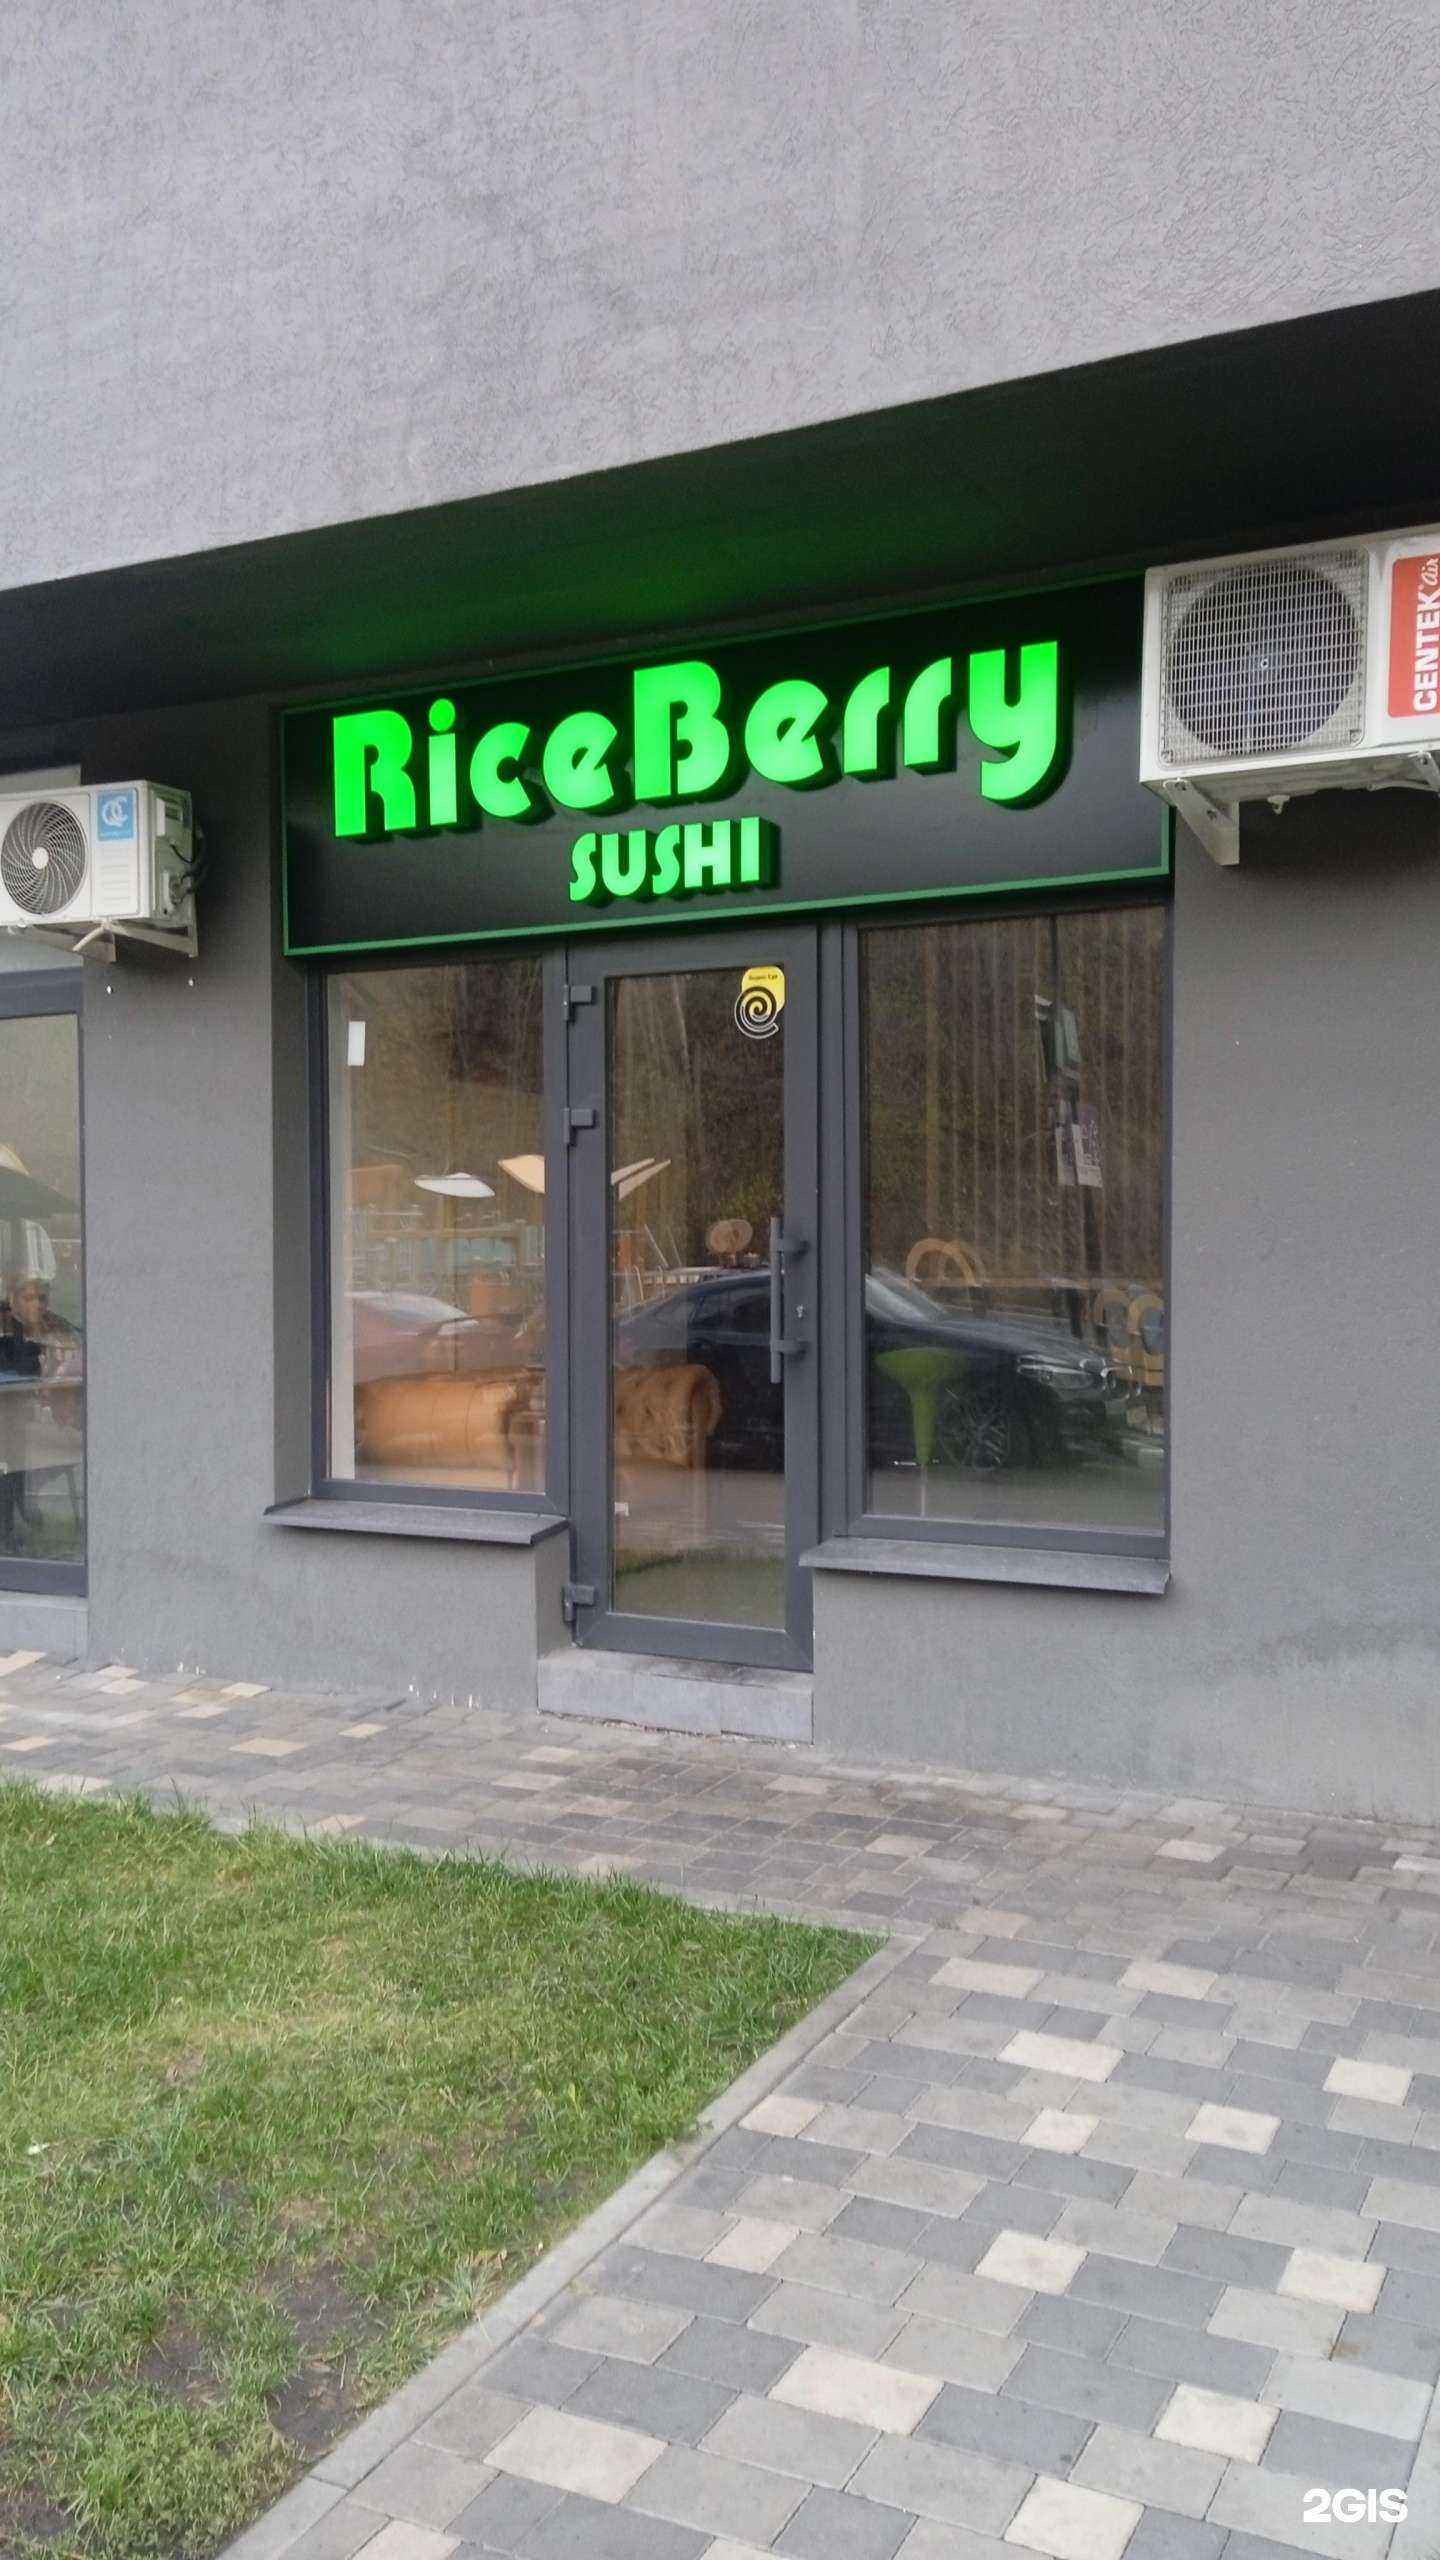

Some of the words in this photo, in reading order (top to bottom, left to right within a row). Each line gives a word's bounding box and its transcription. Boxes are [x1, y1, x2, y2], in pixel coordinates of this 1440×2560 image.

[1413, 589, 1440, 712] CENTEK
[333, 641, 1058, 837] RiceBerry
[569, 817, 761, 901] SUSHI
